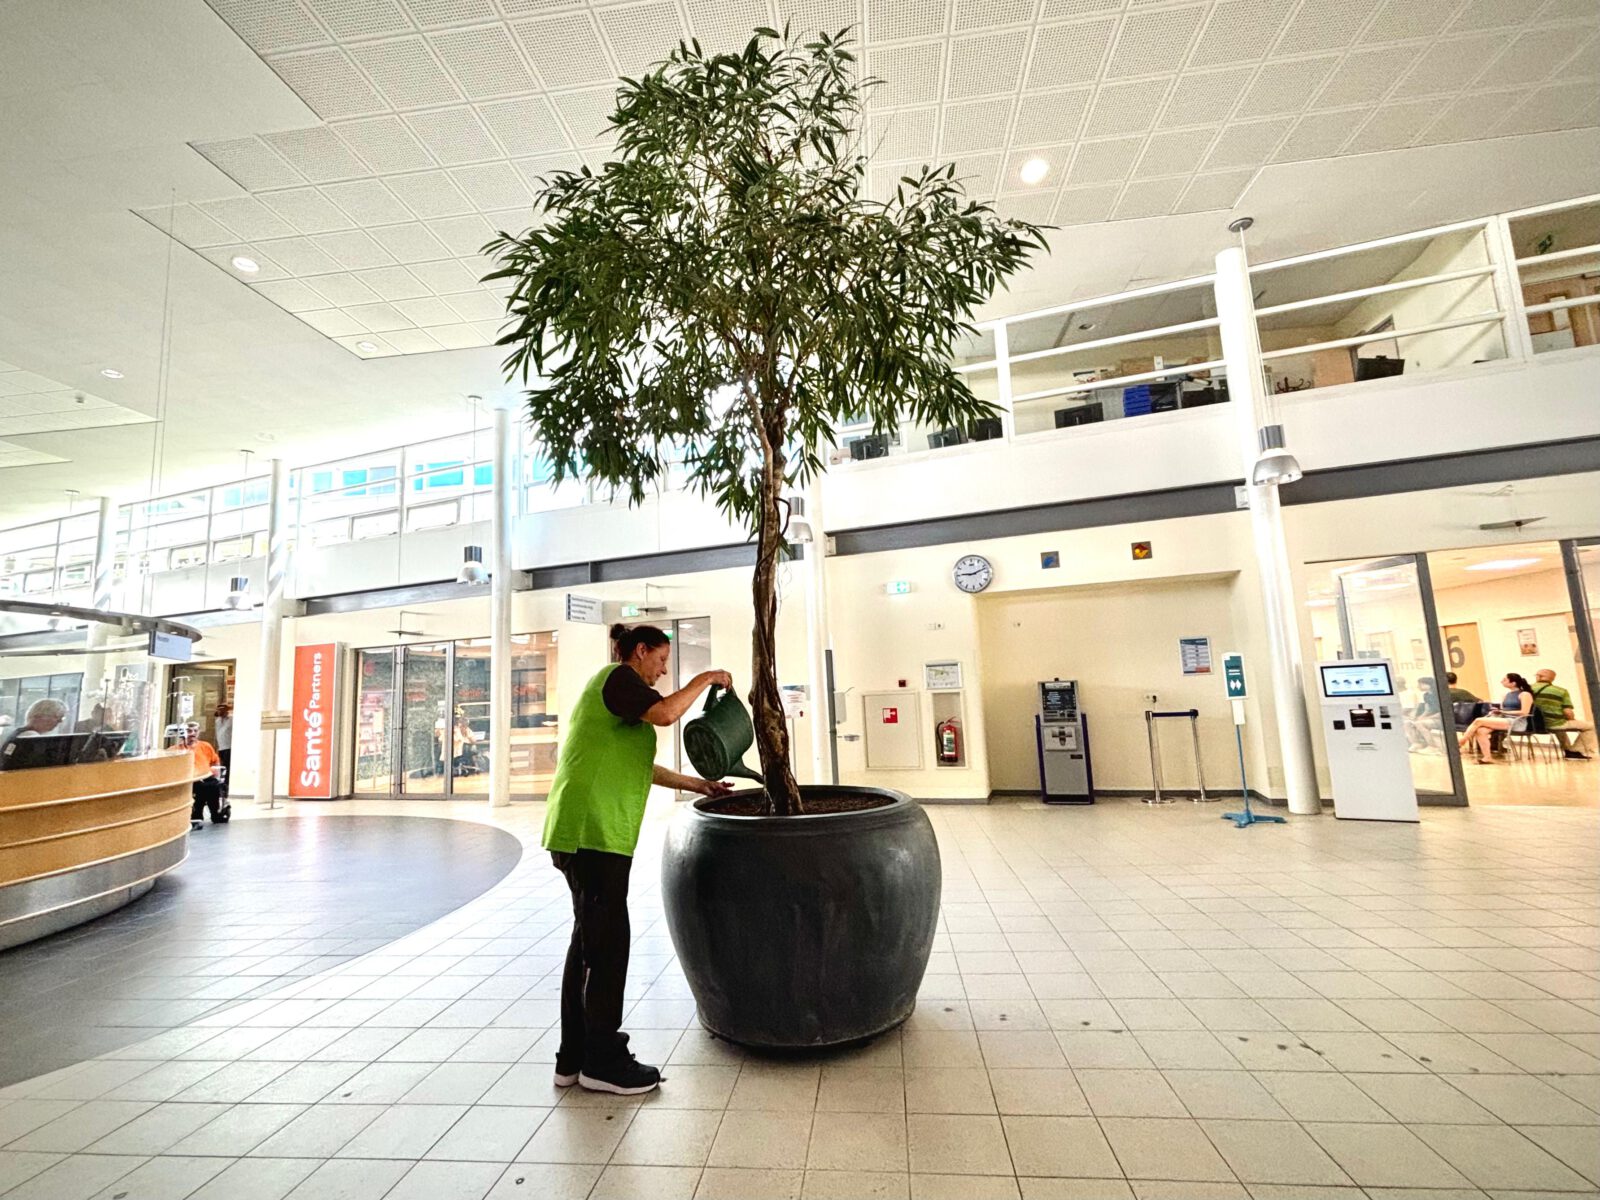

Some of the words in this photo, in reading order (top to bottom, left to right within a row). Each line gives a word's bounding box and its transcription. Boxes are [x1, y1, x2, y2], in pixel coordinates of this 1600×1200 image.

[1446, 635, 1465, 668] 6
[308, 652, 322, 709] Partners
[301, 709, 322, 788] Santé
